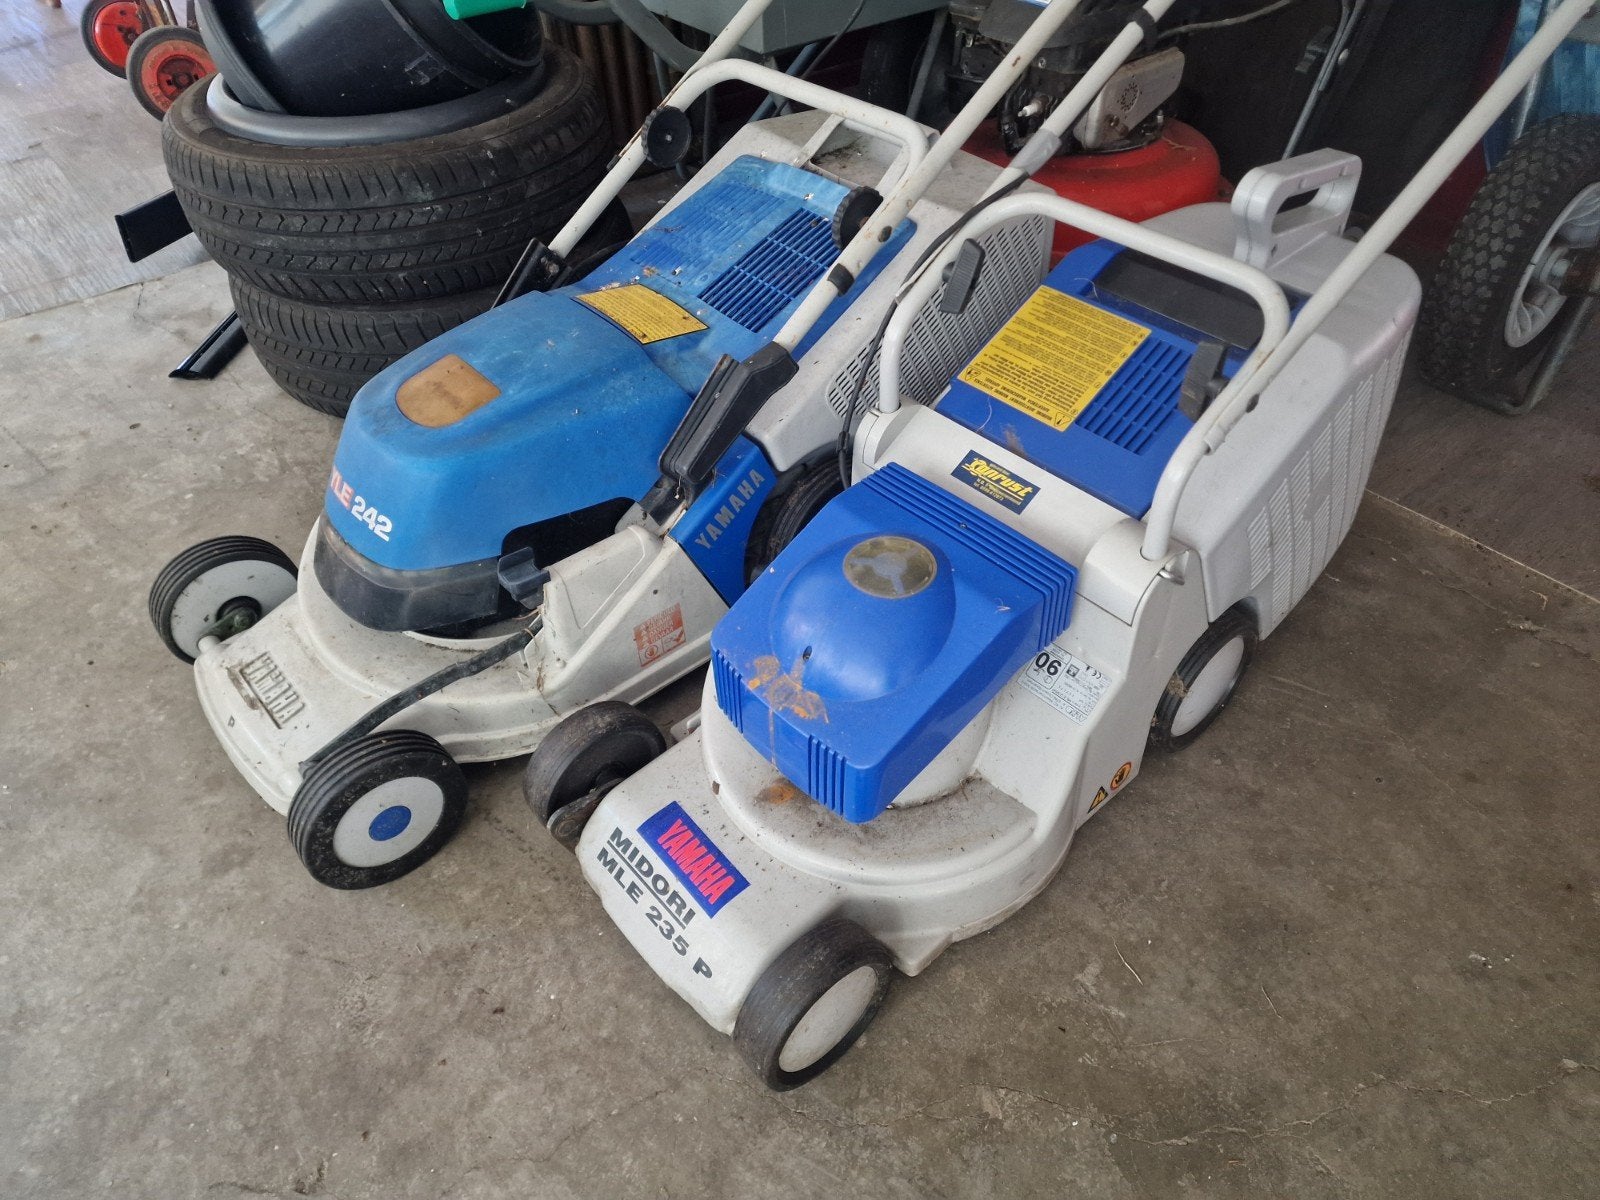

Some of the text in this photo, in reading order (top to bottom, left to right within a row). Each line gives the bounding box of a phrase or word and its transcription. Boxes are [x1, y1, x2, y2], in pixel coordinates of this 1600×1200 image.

[351, 495, 393, 542] 242
[694, 469, 765, 549] YAMAHA
[247, 654, 305, 726] YAMAHA
[608, 826, 697, 927] MIDORI
[657, 818, 736, 905] YAMAHA
[596, 847, 713, 979] MLE 235 P
